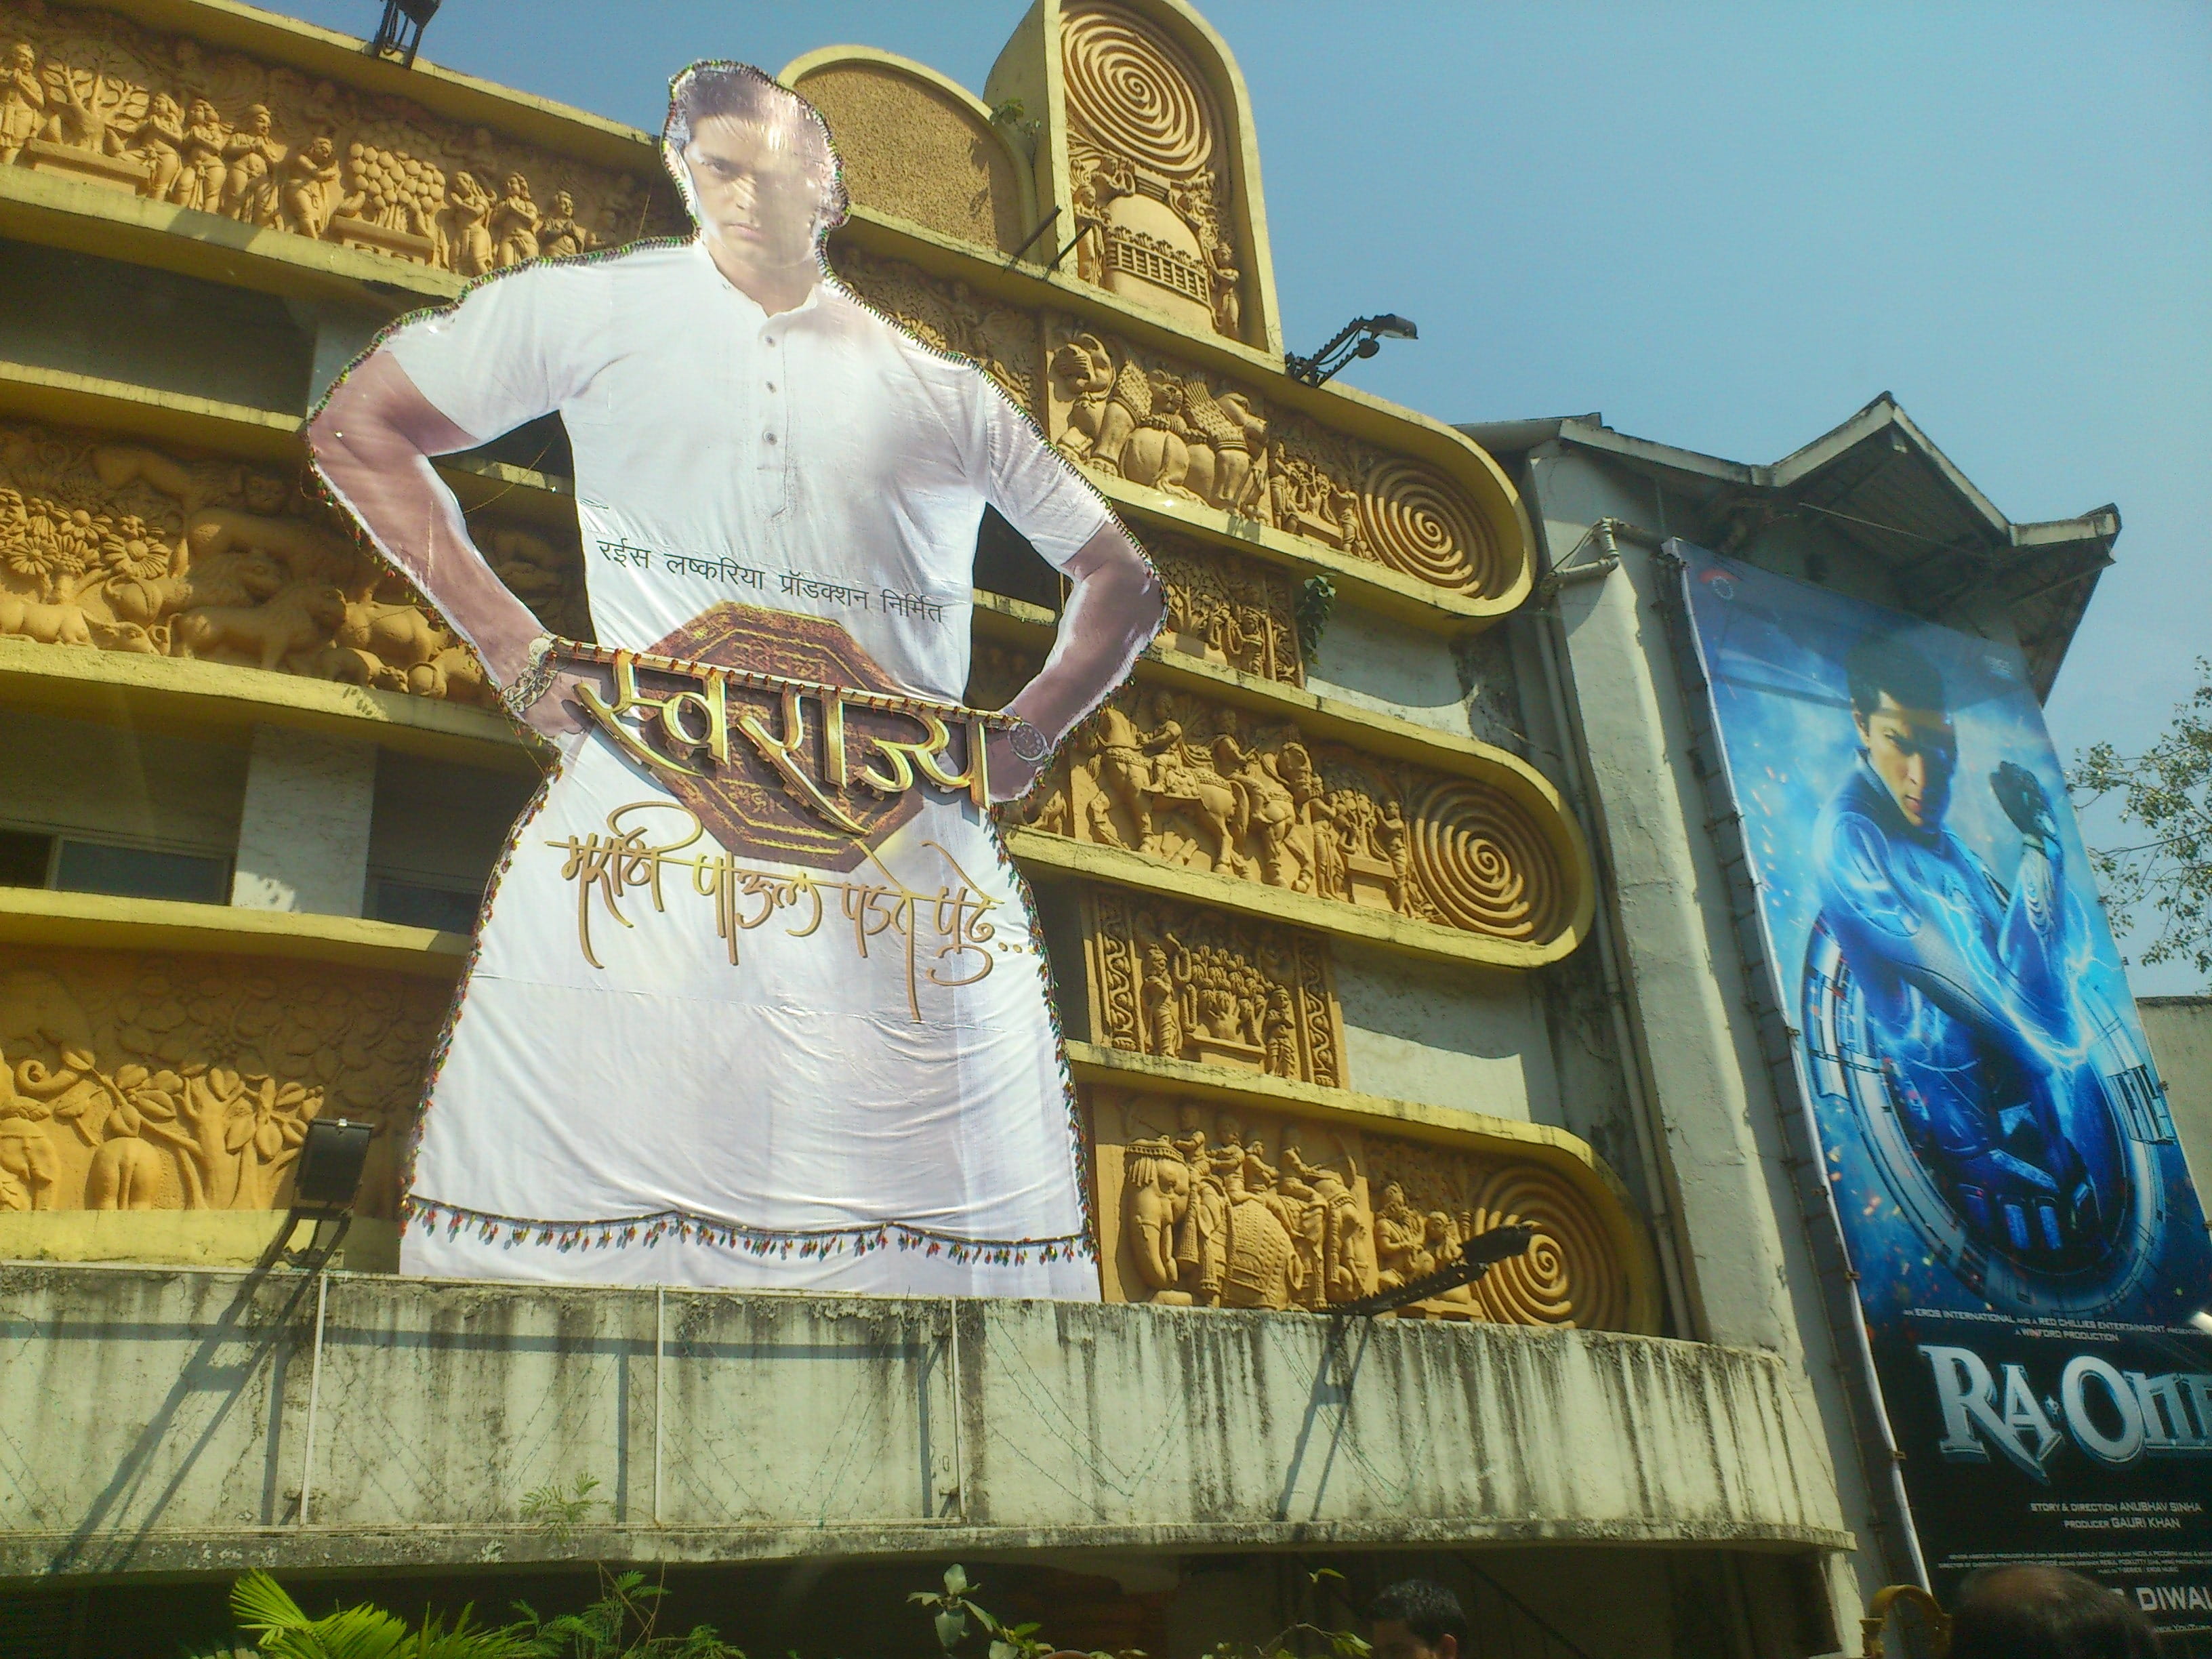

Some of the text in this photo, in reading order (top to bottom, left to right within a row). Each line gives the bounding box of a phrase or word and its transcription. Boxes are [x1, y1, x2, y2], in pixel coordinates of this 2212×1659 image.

[596, 538, 943, 623] रईस लष्करिया प्रॉडक्शन निर्मित
[552, 636, 1022, 836] स्वराज्य
[1942, 1310, 2015, 1324] INTERNATIONAL
[2038, 1317, 2056, 1327] RED
[2057, 1318, 2096, 1330] CHILLIES
[2097, 1321, 2165, 1334] ENTERTAINMENT
[2063, 1330, 2120, 1343] PRODUCTION
[2030, 1502, 2061, 1513] STORY
[2070, 1502, 2119, 1513] DIRECTION
[2119, 1501, 2169, 1513] ANUBHAV
[2169, 1502, 2203, 1513] SINHA
[2063, 1517, 2182, 1529] PRODUCER GAURI KHAN
